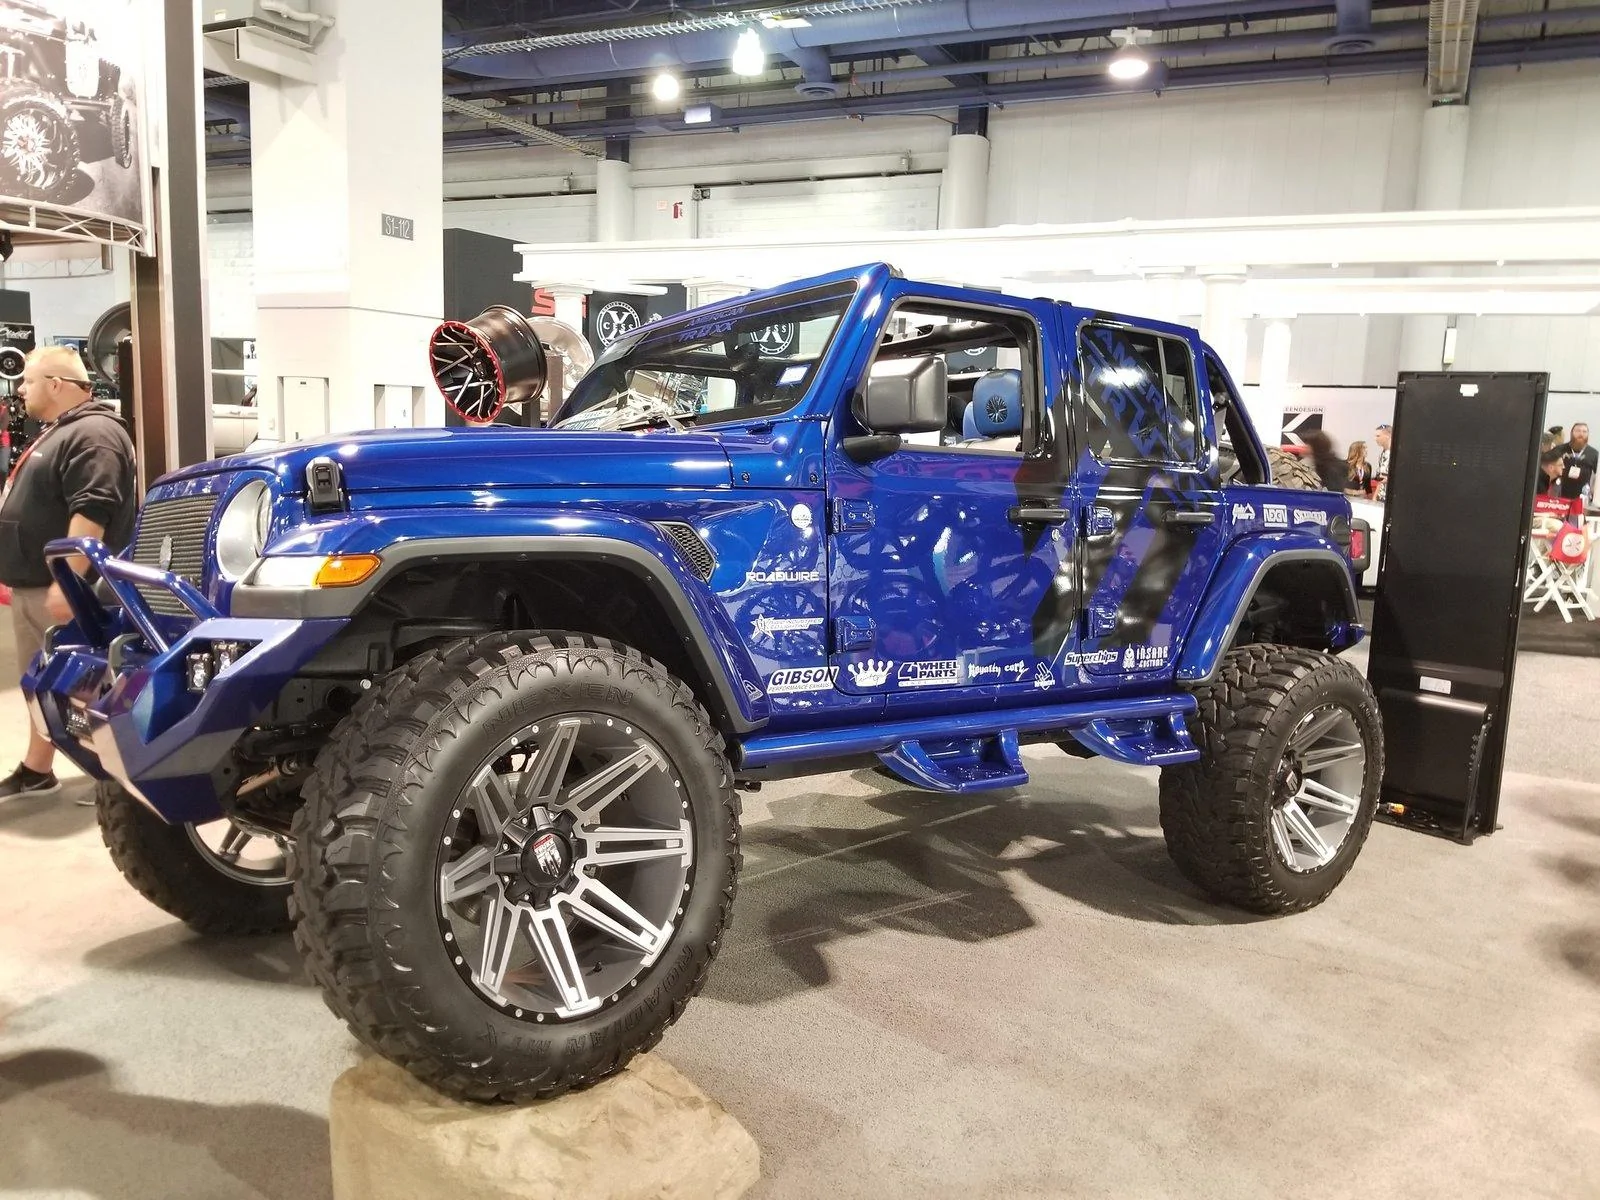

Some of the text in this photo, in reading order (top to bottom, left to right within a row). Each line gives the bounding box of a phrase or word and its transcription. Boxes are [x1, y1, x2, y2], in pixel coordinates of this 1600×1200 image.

[385, 215, 411, 239] S1-112
[745, 571, 820, 582] ROADWIRE
[1064, 650, 1118, 665] Superchips
[771, 668, 838, 686] GIBSON
[899, 662, 919, 679] 4
[919, 661, 959, 671] WHEEL
[919, 669, 957, 679] PARTS
